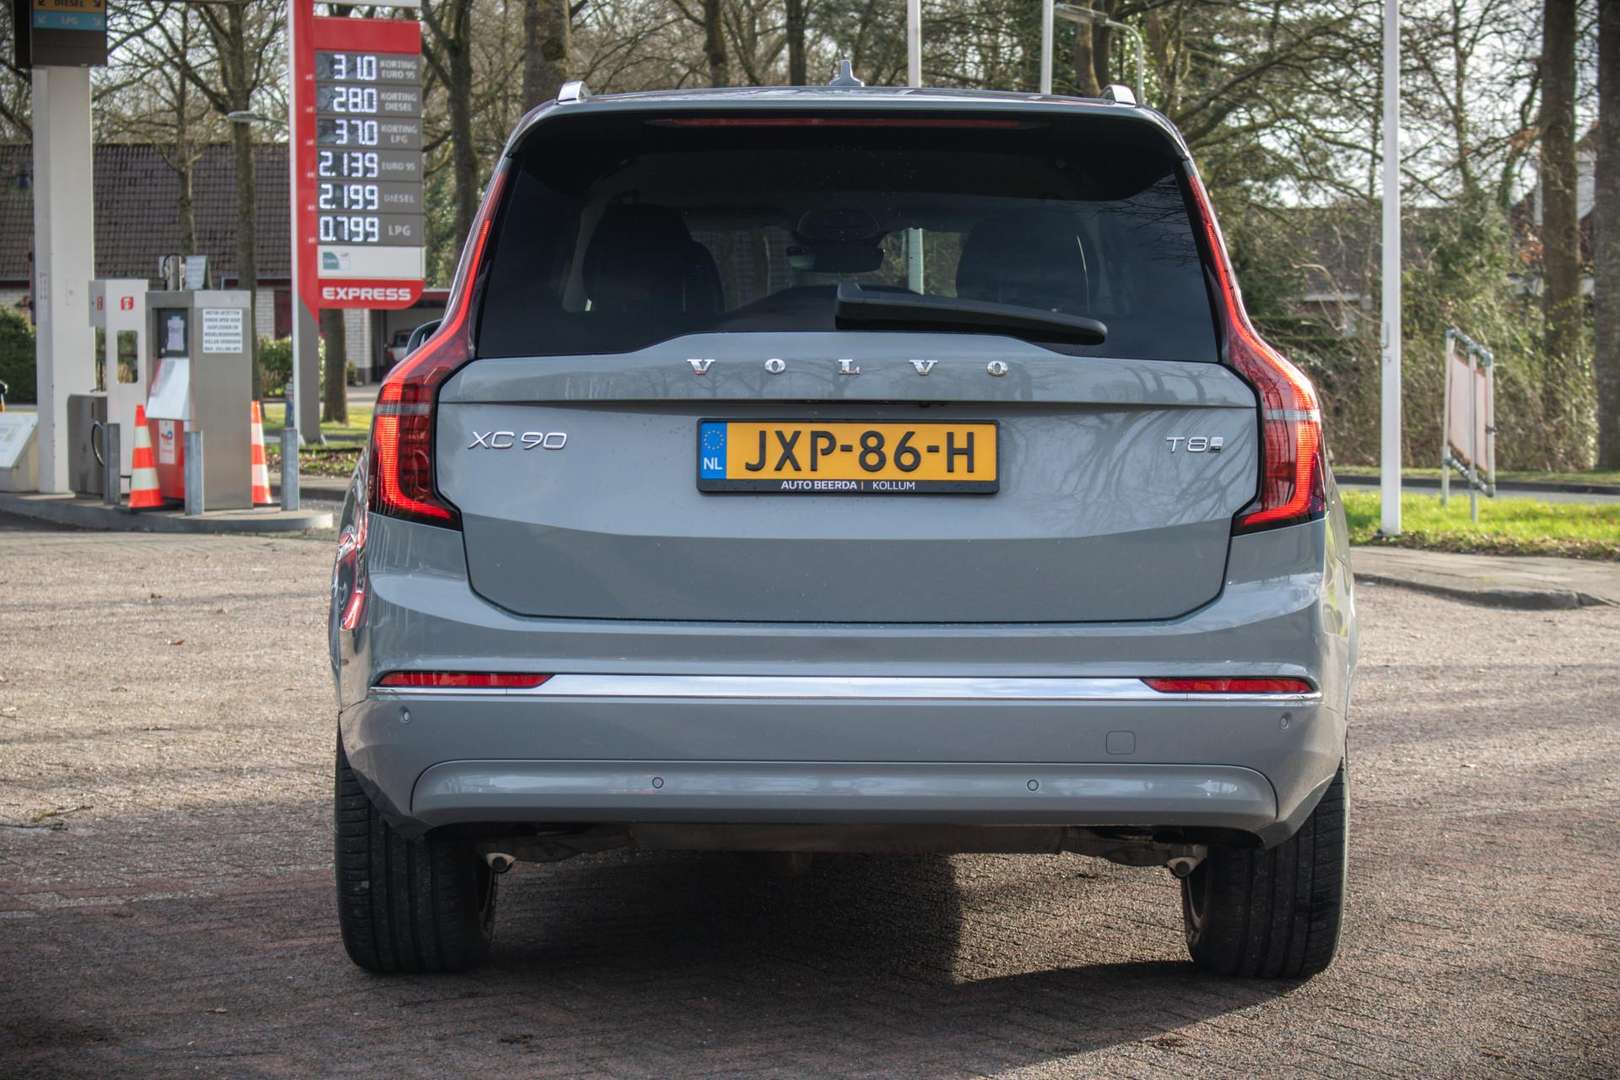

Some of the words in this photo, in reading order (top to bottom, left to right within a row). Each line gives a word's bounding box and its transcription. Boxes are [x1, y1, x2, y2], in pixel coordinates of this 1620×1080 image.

[381, 70, 404, 79] EURO
[405, 70, 416, 79] 95
[385, 103, 412, 112] DIESEL
[390, 135, 408, 144] LPG
[319, 151, 378, 177] 2.139
[381, 162, 404, 171] EURO
[405, 162, 416, 171] 95
[319, 183, 379, 210] 2.199
[383, 194, 415, 203] DIESEL
[319, 216, 379, 242] 0.799
[388, 225, 411, 237] LPG
[322, 287, 411, 301] EXPRESS
[687, 358, 1009, 377] VOLVO
[745, 430, 975, 473] JXP-86-H
[703, 456, 723, 471] NL
[781, 480, 812, 490] AUTO
[814, 480, 857, 490] BEERDA
[872, 481, 915, 490] KOLLUM
